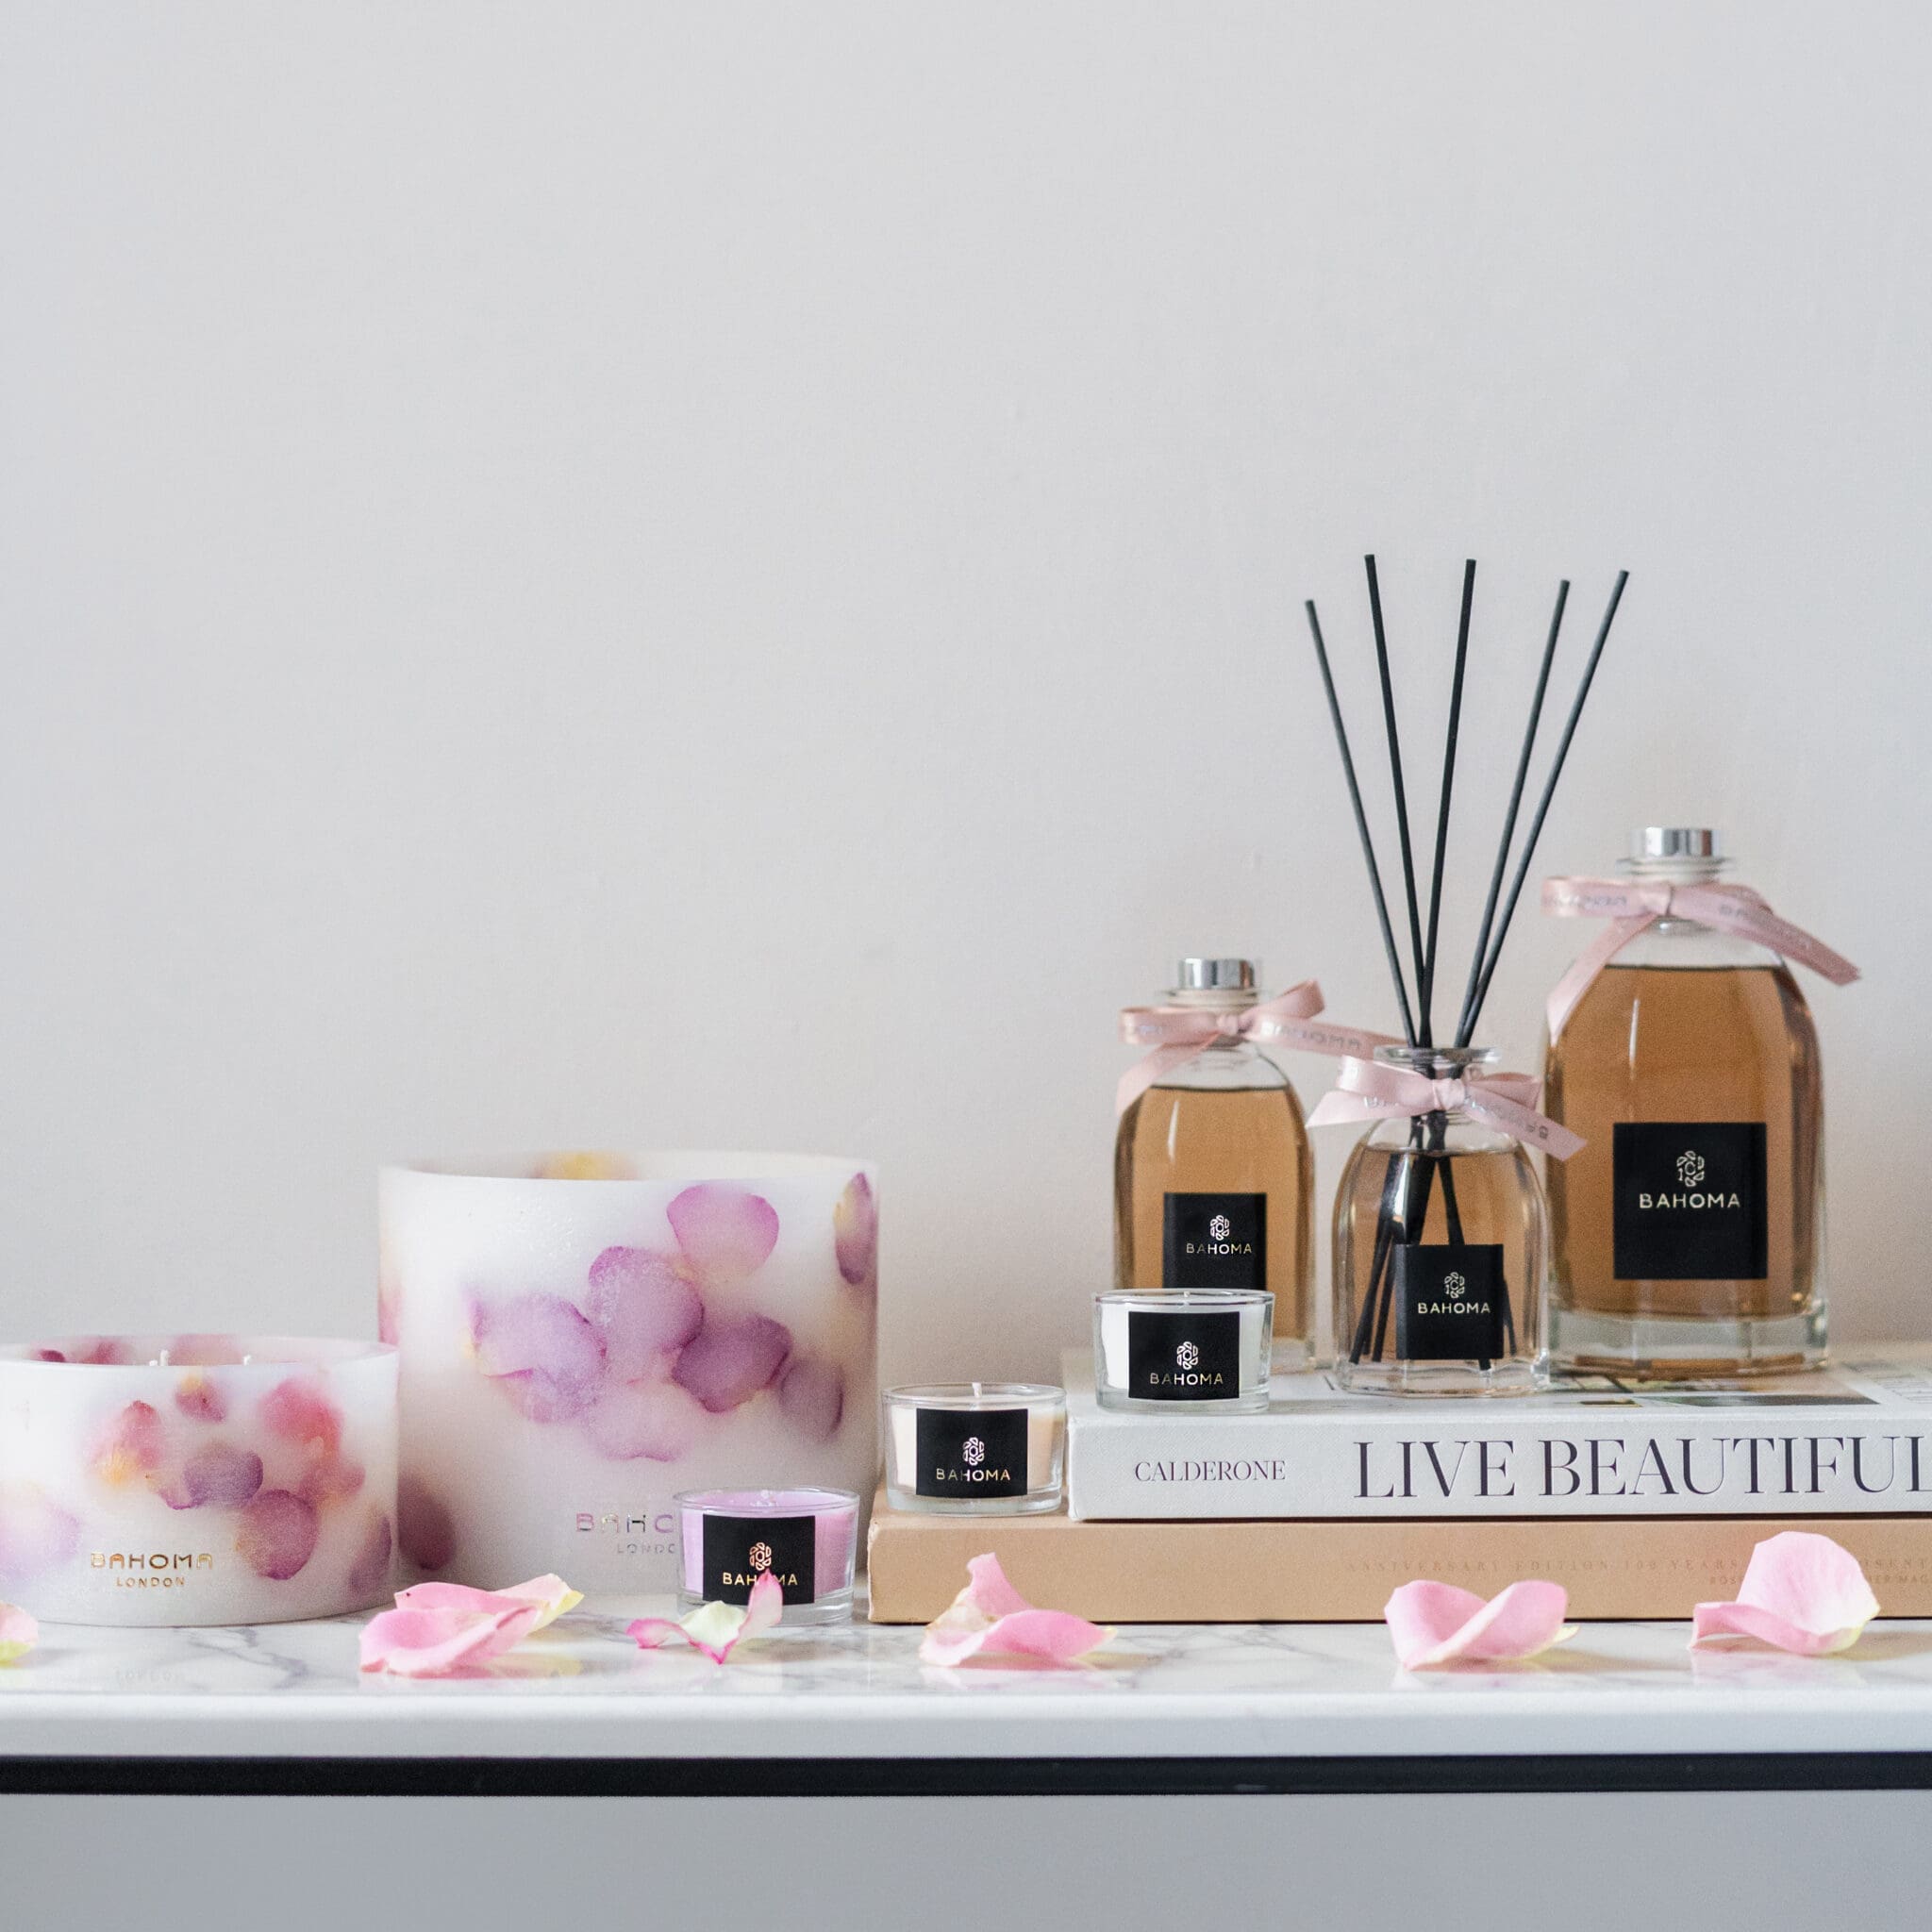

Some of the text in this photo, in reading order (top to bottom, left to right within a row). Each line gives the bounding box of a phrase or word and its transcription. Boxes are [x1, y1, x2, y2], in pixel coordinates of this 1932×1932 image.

[1639, 1192, 1740, 1209] BAHOMA
[1186, 1242, 1252, 1256] BAHOMA
[1417, 1301, 1491, 1315] BAHOMA
[1150, 1372, 1224, 1386] BAHOMA
[936, 1467, 1010, 1482] BAHOMA
[1134, 1460, 1286, 1482] CALDERONE
[1353, 1436, 1932, 1498] LIVE BEAUTIFUL
[91, 1552, 213, 1570] BAHOMA
[117, 1576, 185, 1588] LONDON
[722, 1571, 798, 1586] BAHMA
